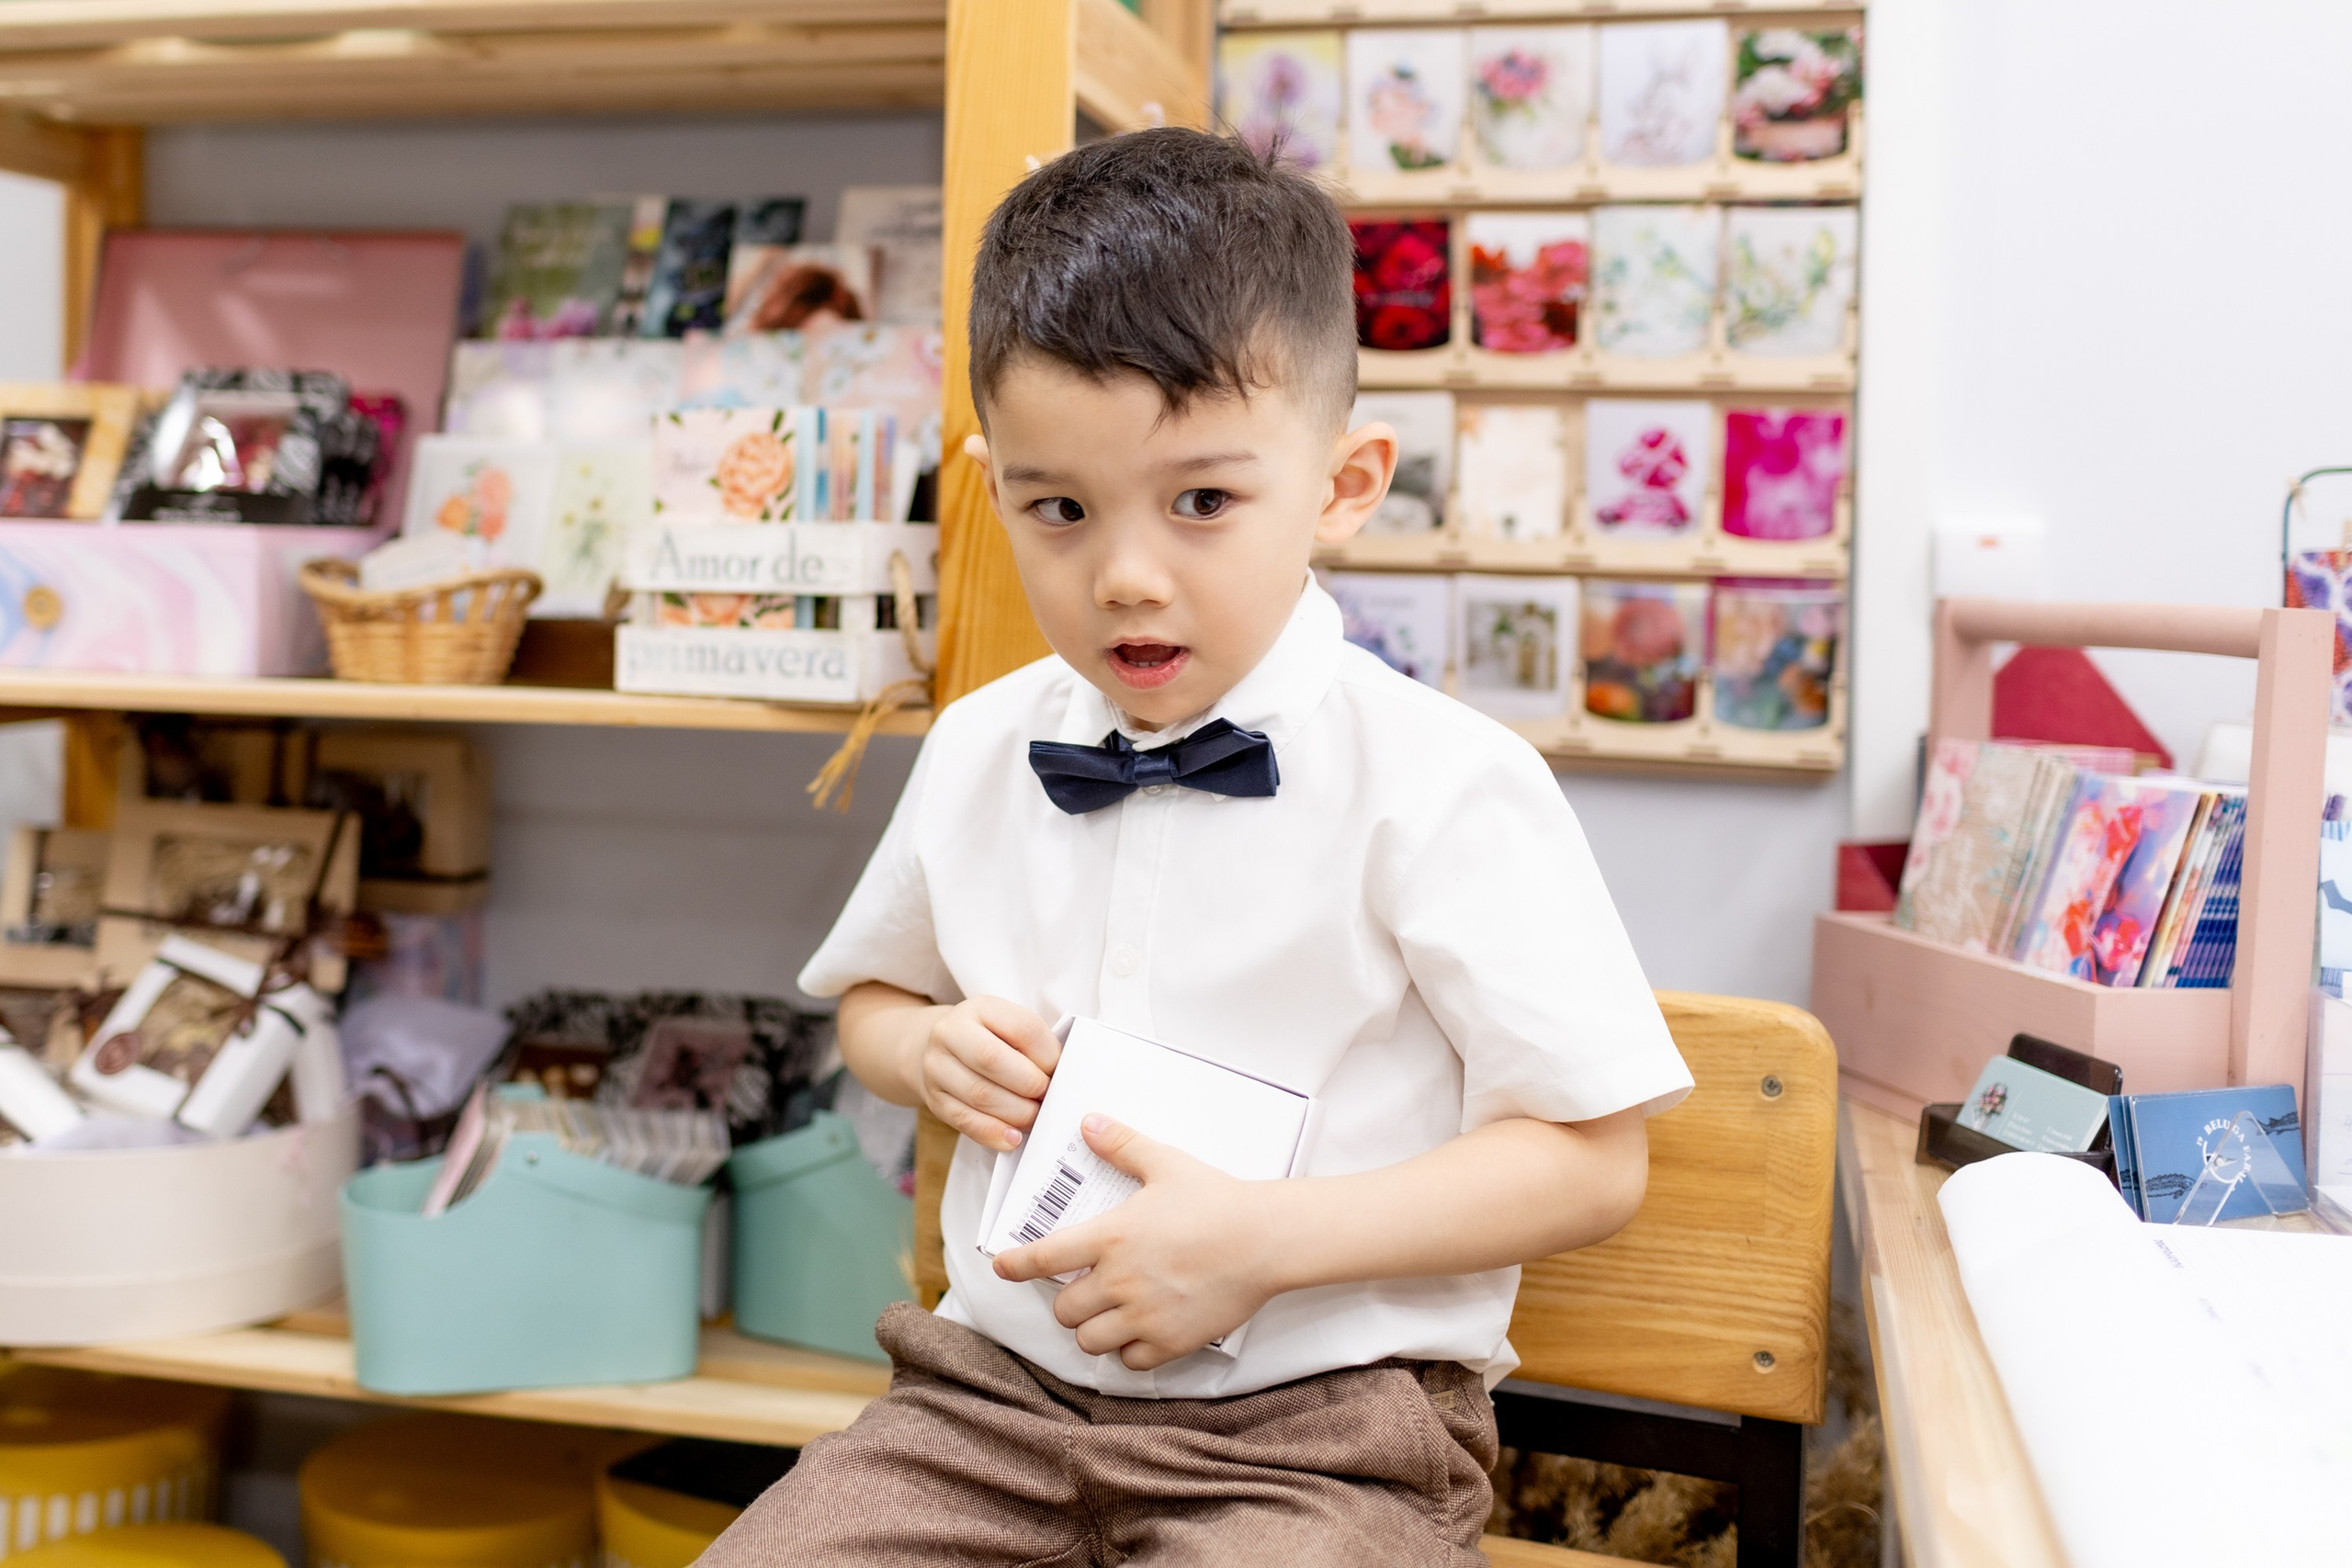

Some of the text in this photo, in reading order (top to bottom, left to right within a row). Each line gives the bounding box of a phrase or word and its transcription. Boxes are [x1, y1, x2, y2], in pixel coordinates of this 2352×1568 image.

[650, 527, 825, 584] Amor de
[628, 641, 846, 682] primavera
[2204, 1118, 2245, 1143] BELUGA
